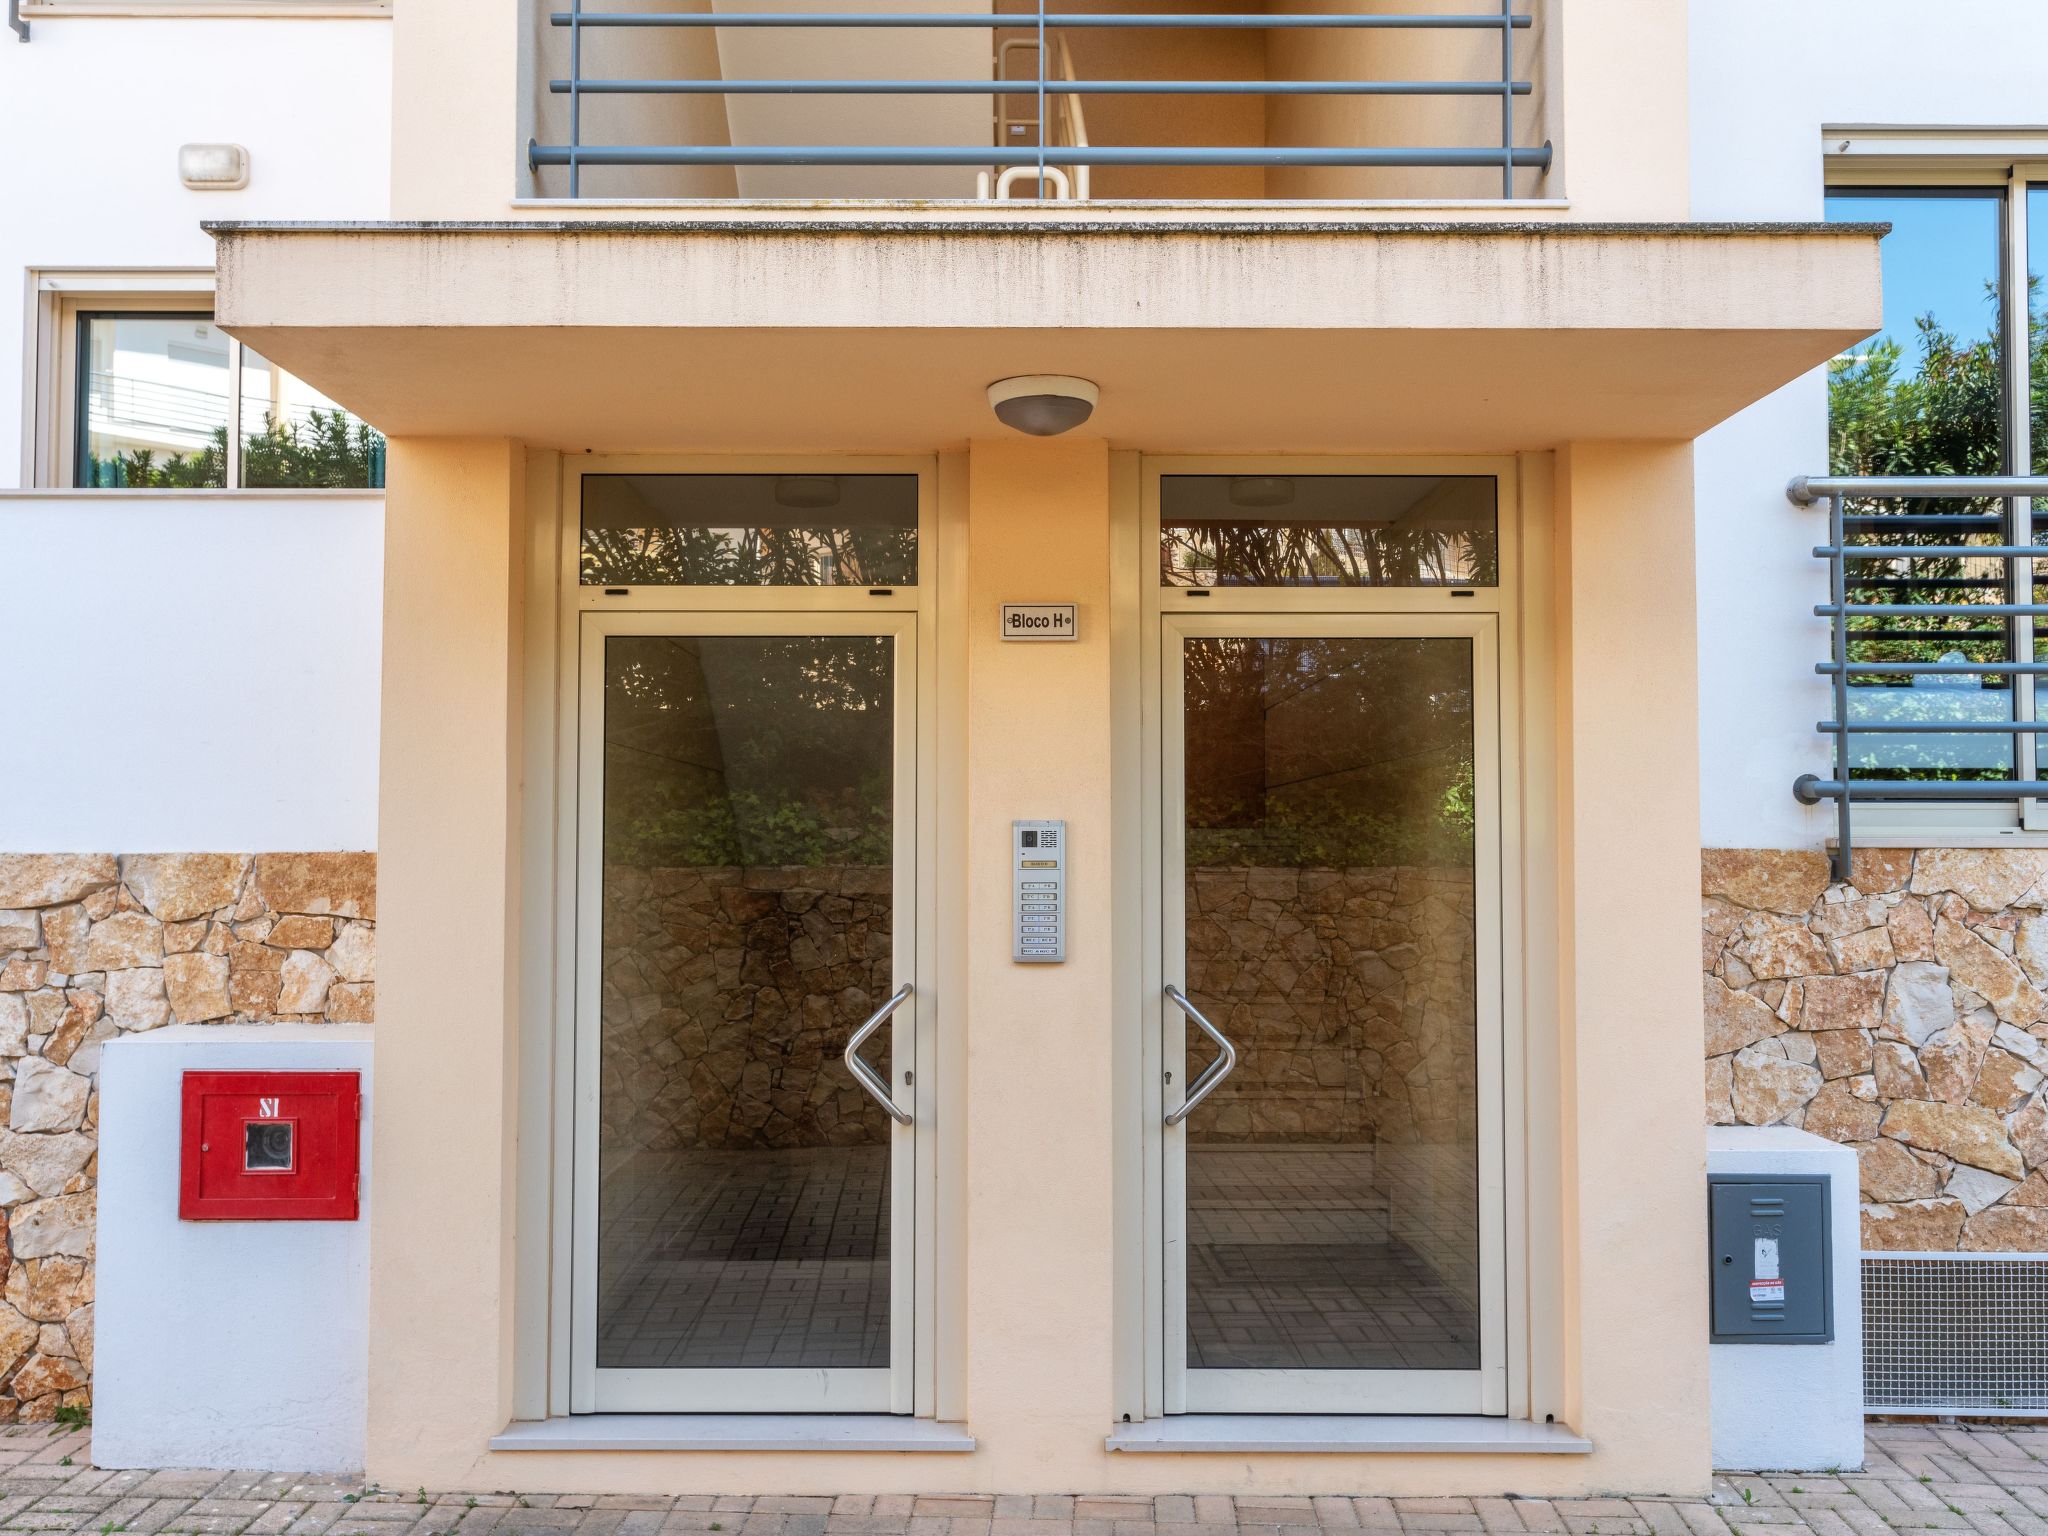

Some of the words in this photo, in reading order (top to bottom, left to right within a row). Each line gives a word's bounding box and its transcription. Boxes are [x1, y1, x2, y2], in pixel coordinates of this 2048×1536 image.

[1012, 613, 1050, 628] Bloco
[1053, 613, 1063, 627] H
[259, 1098, 280, 1118] SI
